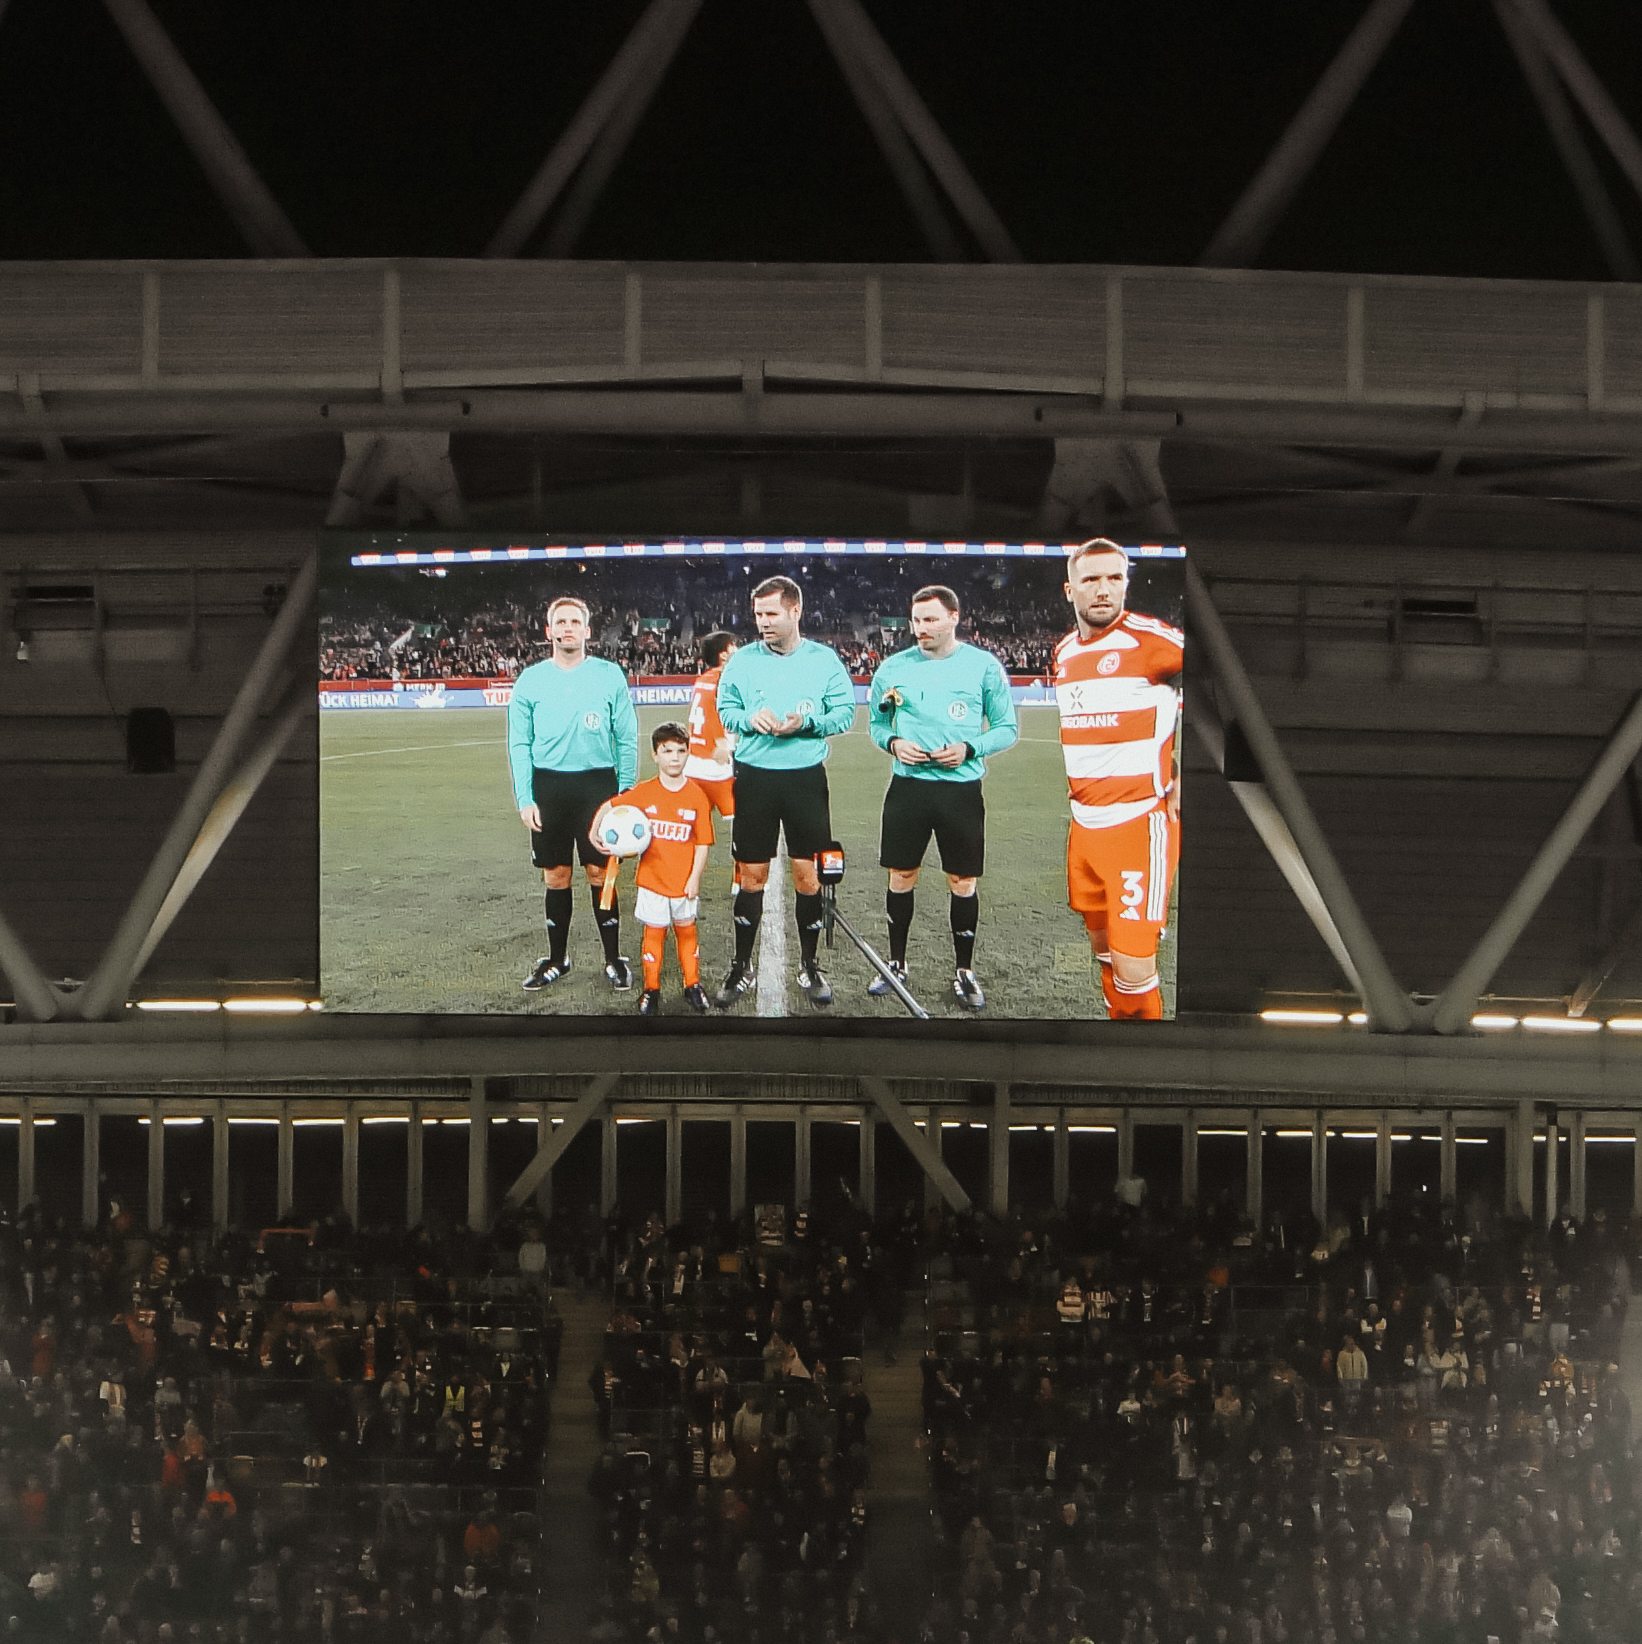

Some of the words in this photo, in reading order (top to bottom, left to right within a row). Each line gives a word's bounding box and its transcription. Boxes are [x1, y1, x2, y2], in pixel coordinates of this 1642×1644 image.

[351, 692, 399, 708] HEIMAT
[637, 687, 692, 703] HEIMAT
[1120, 871, 1144, 906] 3
